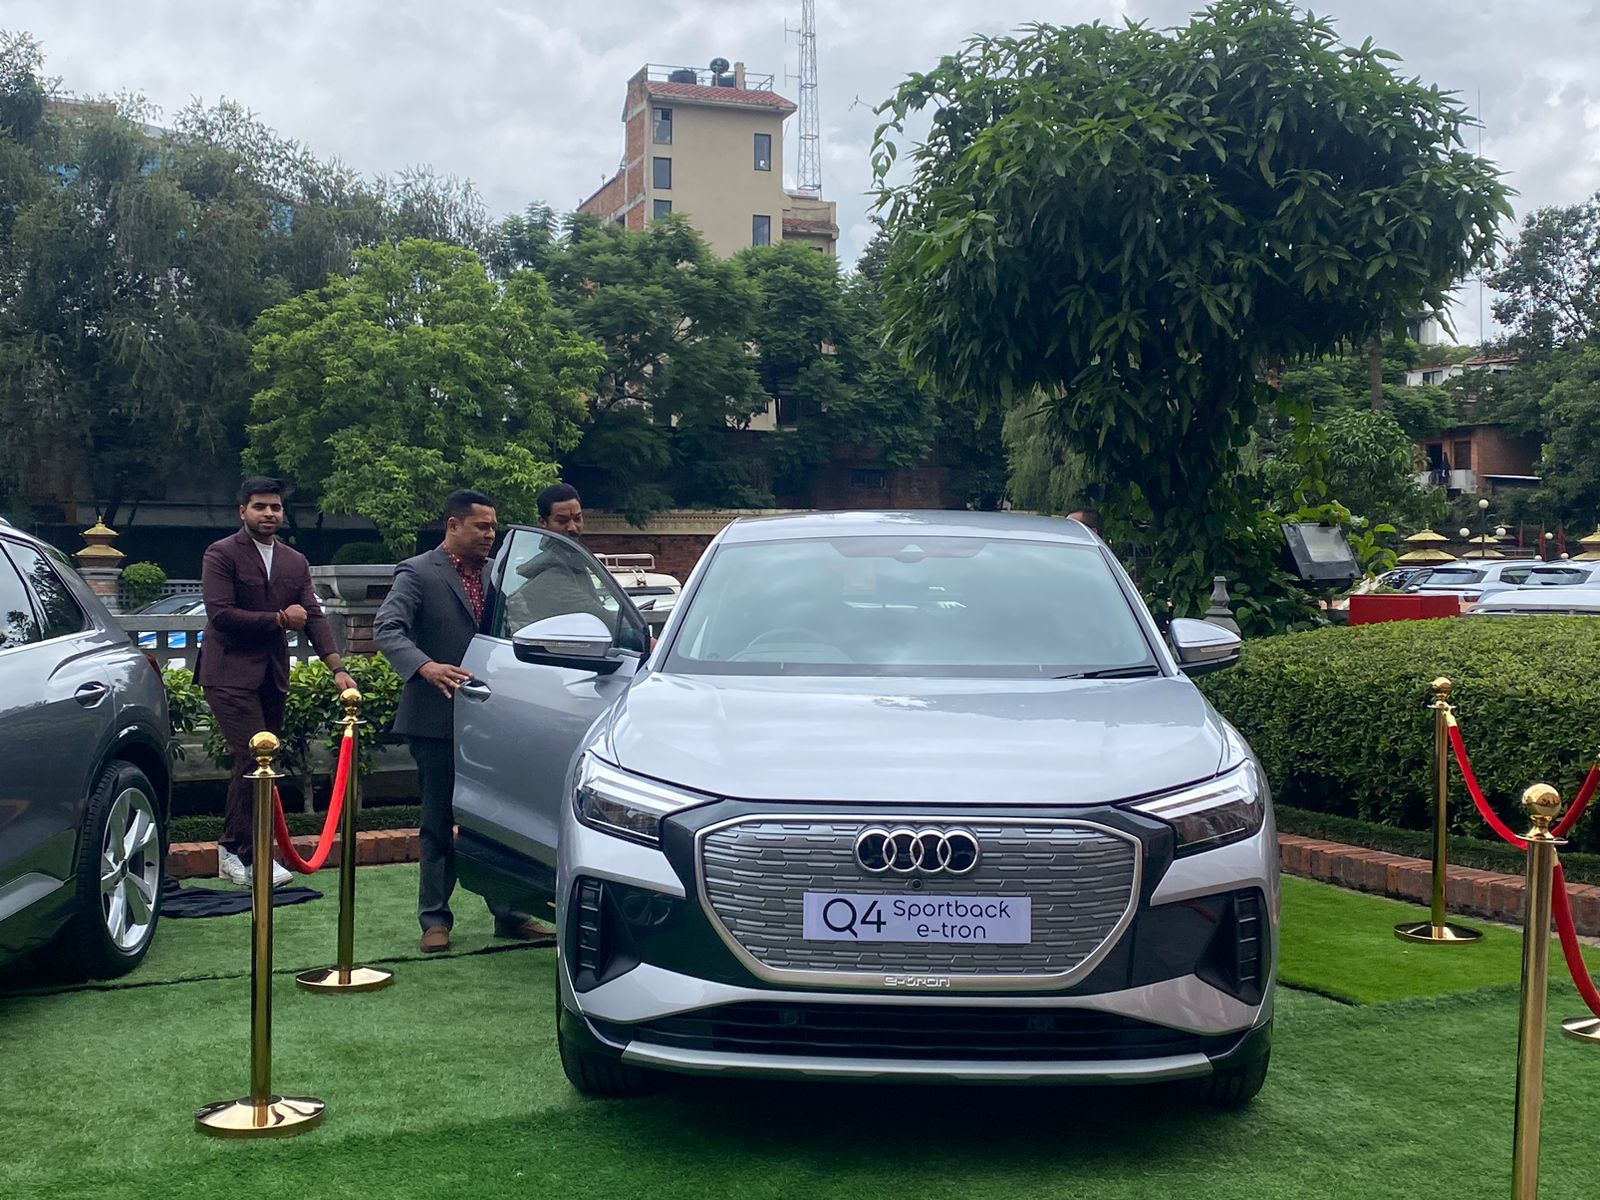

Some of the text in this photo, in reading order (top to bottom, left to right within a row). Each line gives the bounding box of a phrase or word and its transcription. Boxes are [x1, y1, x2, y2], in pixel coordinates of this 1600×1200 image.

[822, 897, 1011, 939] Q4 Sportback
[916, 921, 986, 939] e-tron
[883, 976, 951, 988] e-tron
